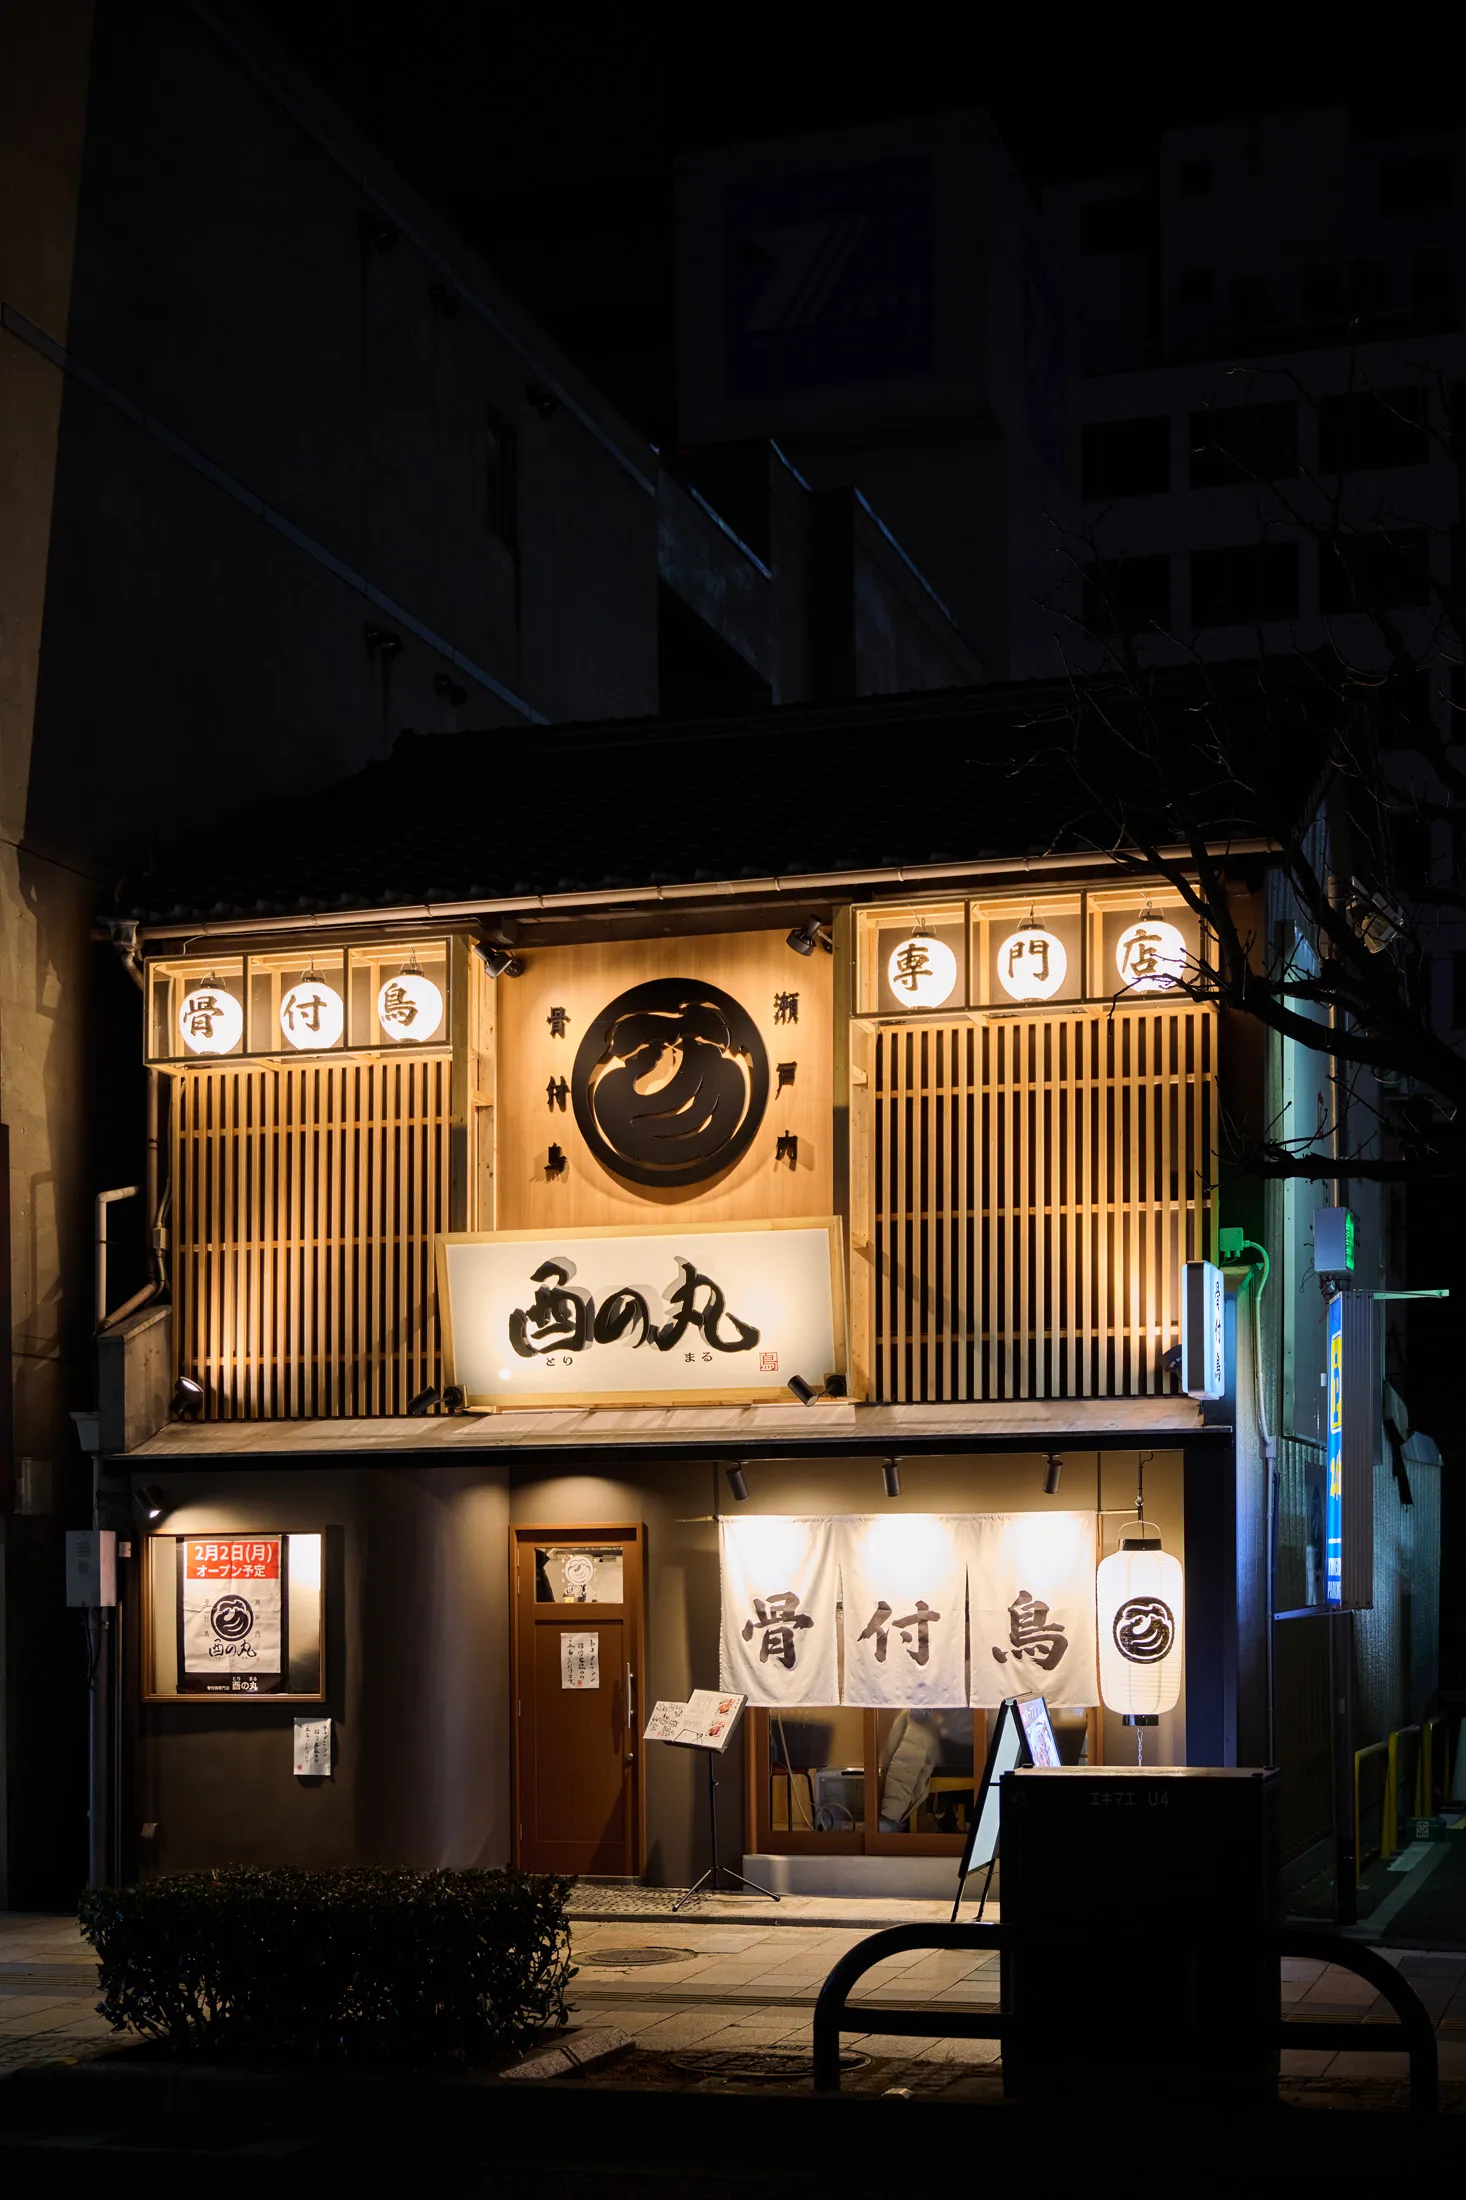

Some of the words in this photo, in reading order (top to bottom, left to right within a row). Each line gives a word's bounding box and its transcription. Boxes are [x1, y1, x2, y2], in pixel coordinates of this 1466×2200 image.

[774, 991, 800, 1171] 瀬戸内
[546, 1355, 573, 1367] とり
[684, 1352, 712, 1364] まる
[195, 1544, 273, 1563] 2月2日(月)
[196, 1564, 266, 1577] オープン予定
[742, 1590, 1068, 1671] 骨付鳥
